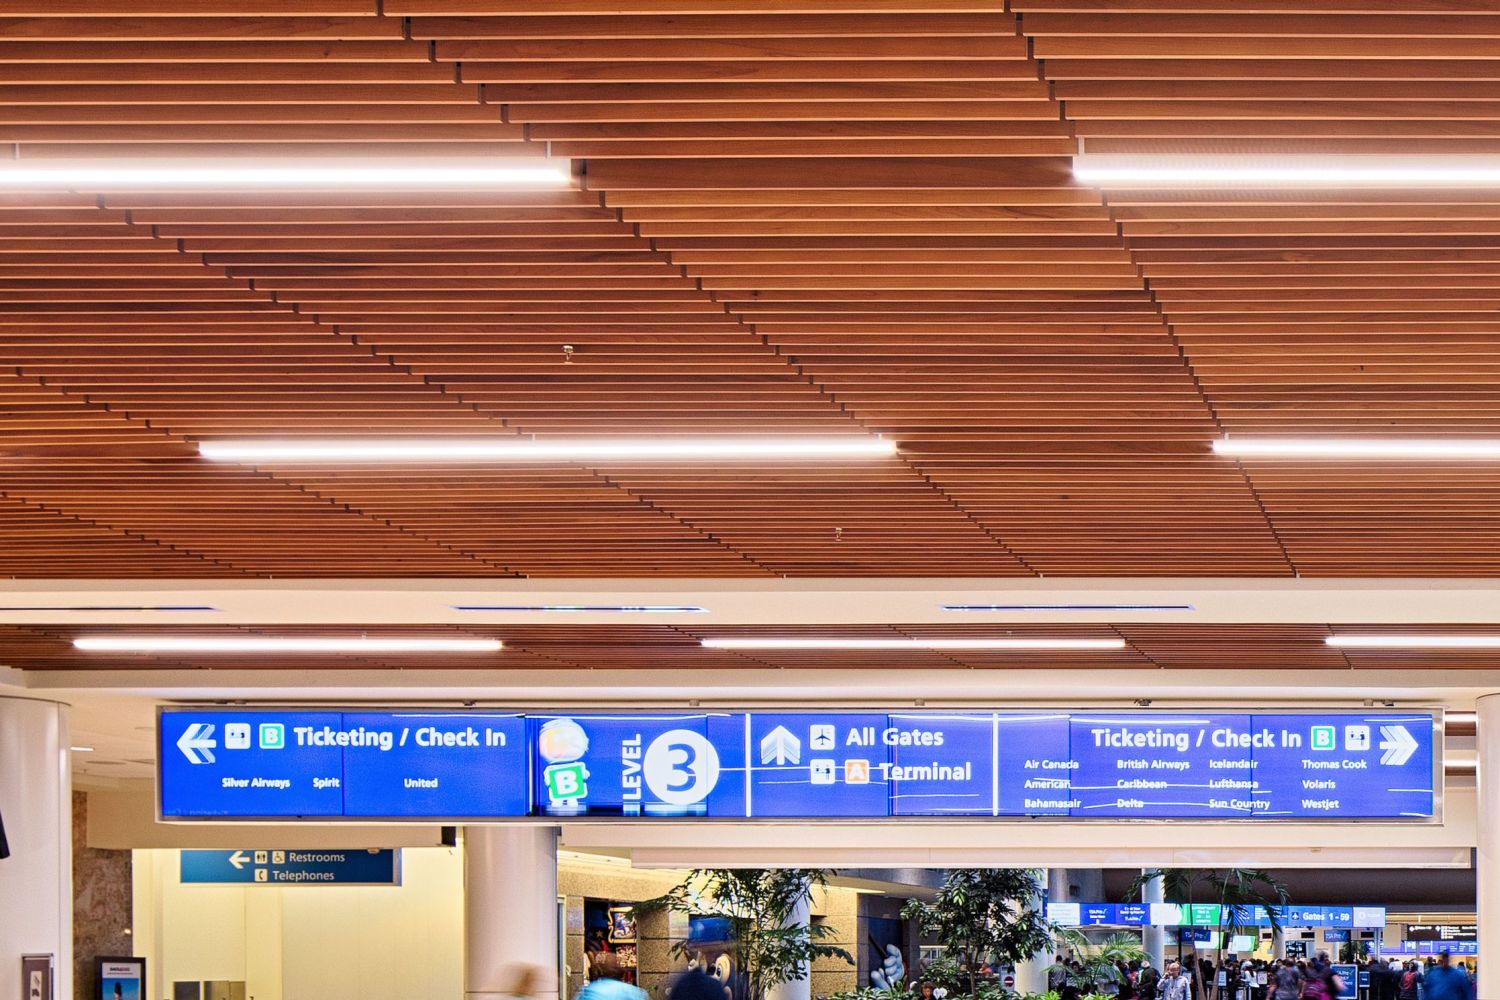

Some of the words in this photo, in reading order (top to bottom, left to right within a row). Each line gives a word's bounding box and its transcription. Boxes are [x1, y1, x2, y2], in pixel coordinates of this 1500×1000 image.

[265, 728, 279, 744] B
[293, 727, 393, 751] Ticketing
[399, 727, 409, 747] /
[415, 727, 480, 747] Check
[486, 728, 506, 747] In
[846, 727, 875, 746] All
[882, 728, 944, 746] Gates
[1091, 728, 1189, 752] Ticketing
[1195, 729, 1205, 747] /
[1211, 728, 1275, 748] Check
[1281, 730, 1302, 747] In
[1315, 729, 1330, 746] B
[622, 733, 641, 800] LEVEL
[666, 743, 697, 792] 3
[1024, 760, 1039, 769] Air
[1042, 760, 1079, 769] Canada
[1117, 760, 1148, 769] British
[1151, 760, 1190, 771] Airways
[1209, 760, 1258, 769] Icelandair
[1302, 760, 1340, 769] Thomas
[1342, 760, 1367, 769] Cook
[878, 762, 971, 781] Terminal
[222, 777, 249, 788] Silver
[251, 778, 291, 790] Airways
[312, 777, 340, 789] Spirit
[404, 778, 438, 788] United
[554, 770, 579, 795] B
[1024, 779, 1071, 789] American
[1117, 779, 1167, 789] Caribbean
[1209, 779, 1258, 789] Lufthansa
[1302, 779, 1336, 789] Volaris
[1024, 799, 1081, 808] Bahamasair
[1117, 799, 1144, 808] Delta
[1209, 799, 1227, 808] Sun
[1230, 799, 1270, 810] Country
[1302, 799, 1340, 810] Westjet
[289, 852, 345, 862] Restrooms
[272, 870, 335, 882] Telephones
[1302, 912, 1325, 920] Gates
